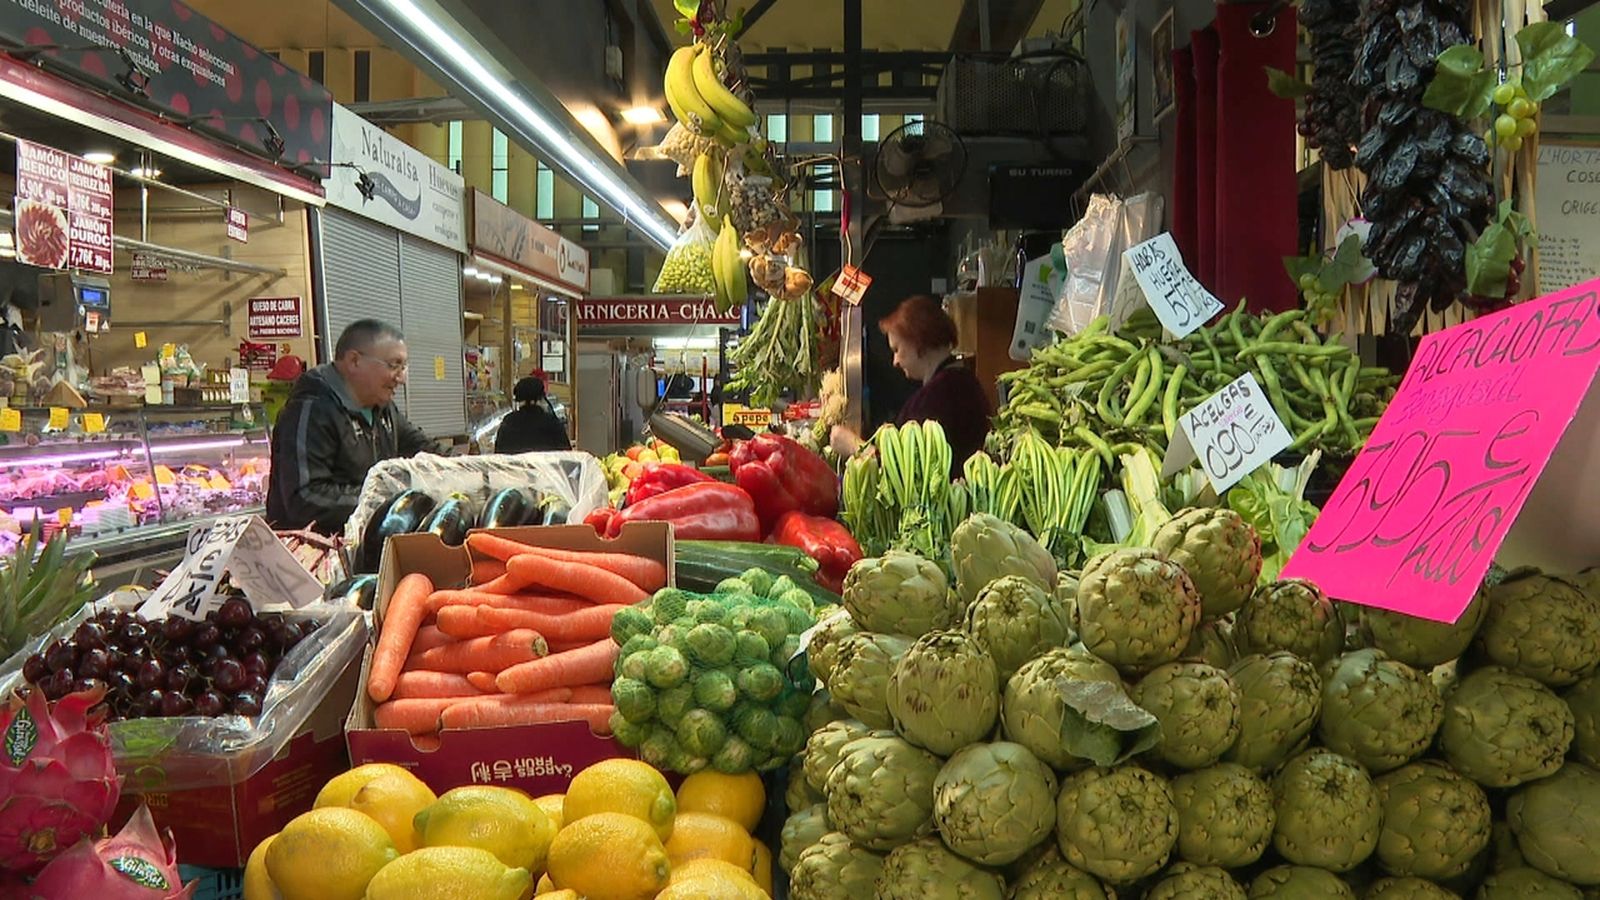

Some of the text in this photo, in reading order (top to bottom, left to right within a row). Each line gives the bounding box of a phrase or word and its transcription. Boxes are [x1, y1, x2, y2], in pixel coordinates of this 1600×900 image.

[19, 0, 61, 25] deleite
[62, 14, 77, 32] de
[60, 0, 111, 29] productos
[111, 19, 149, 49] ibéricos
[150, 40, 157, 56] y
[158, 45, 180, 64] otras
[131, 13, 144, 29] en
[145, 16, 153, 32] la
[154, 24, 171, 41] que
[172, 30, 198, 54] Nacho
[198, 47, 235, 75] selecciona
[361, 125, 419, 182] Naturalsa
[71, 160, 108, 180] JAMÓN
[1008, 168, 1073, 177] SU TURNO
[1561, 199, 1600, 216] ORIGE
[72, 216, 108, 234] JAMÓN
[70, 228, 111, 246] DUROC
[1131, 240, 1166, 275] HABAS
[269, 300, 278, 311] DE
[1190, 379, 1252, 439] ACELGAS
[514, 756, 554, 769] FRUIT
